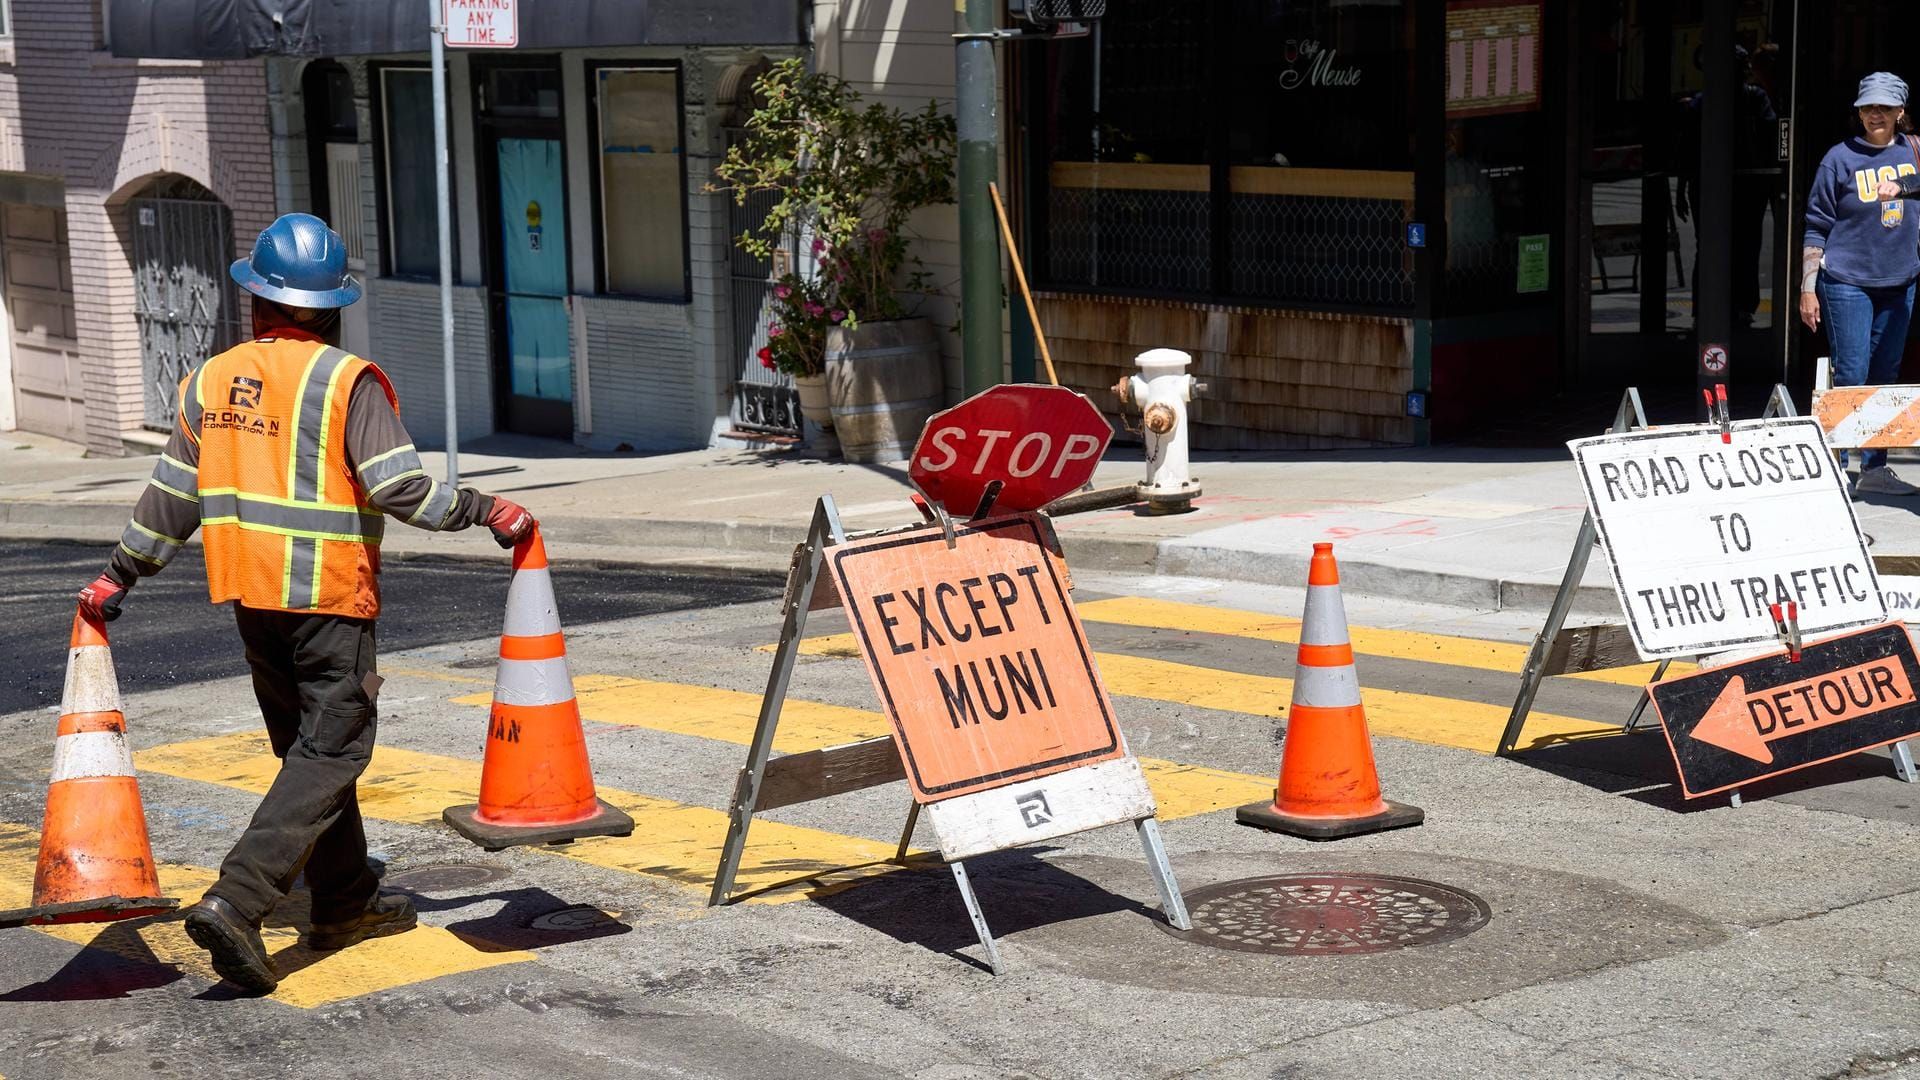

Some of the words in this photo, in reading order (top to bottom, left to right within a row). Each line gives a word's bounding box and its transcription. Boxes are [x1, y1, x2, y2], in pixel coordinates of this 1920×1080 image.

[451, 0, 509, 10] PARKING
[467, 11, 493, 26] ANY
[466, 27, 496, 42] TIME
[1279, 49, 1362, 90] Meuse
[1780, 122, 1789, 157] PUSH
[1525, 242, 1544, 253] PASS
[204, 412, 280, 431] RONAN
[919, 426, 1100, 479] STOP
[1599, 456, 1690, 502] ROAD
[1698, 443, 1822, 491] CLOSED
[1710, 512, 1752, 554] TO
[872, 565, 1052, 656] EXCEPT
[1637, 581, 1726, 630] THRU
[1730, 563, 1867, 618] TRAFFIC
[934, 648, 1057, 729] MUNI
[1746, 666, 1902, 736] DETOUR
